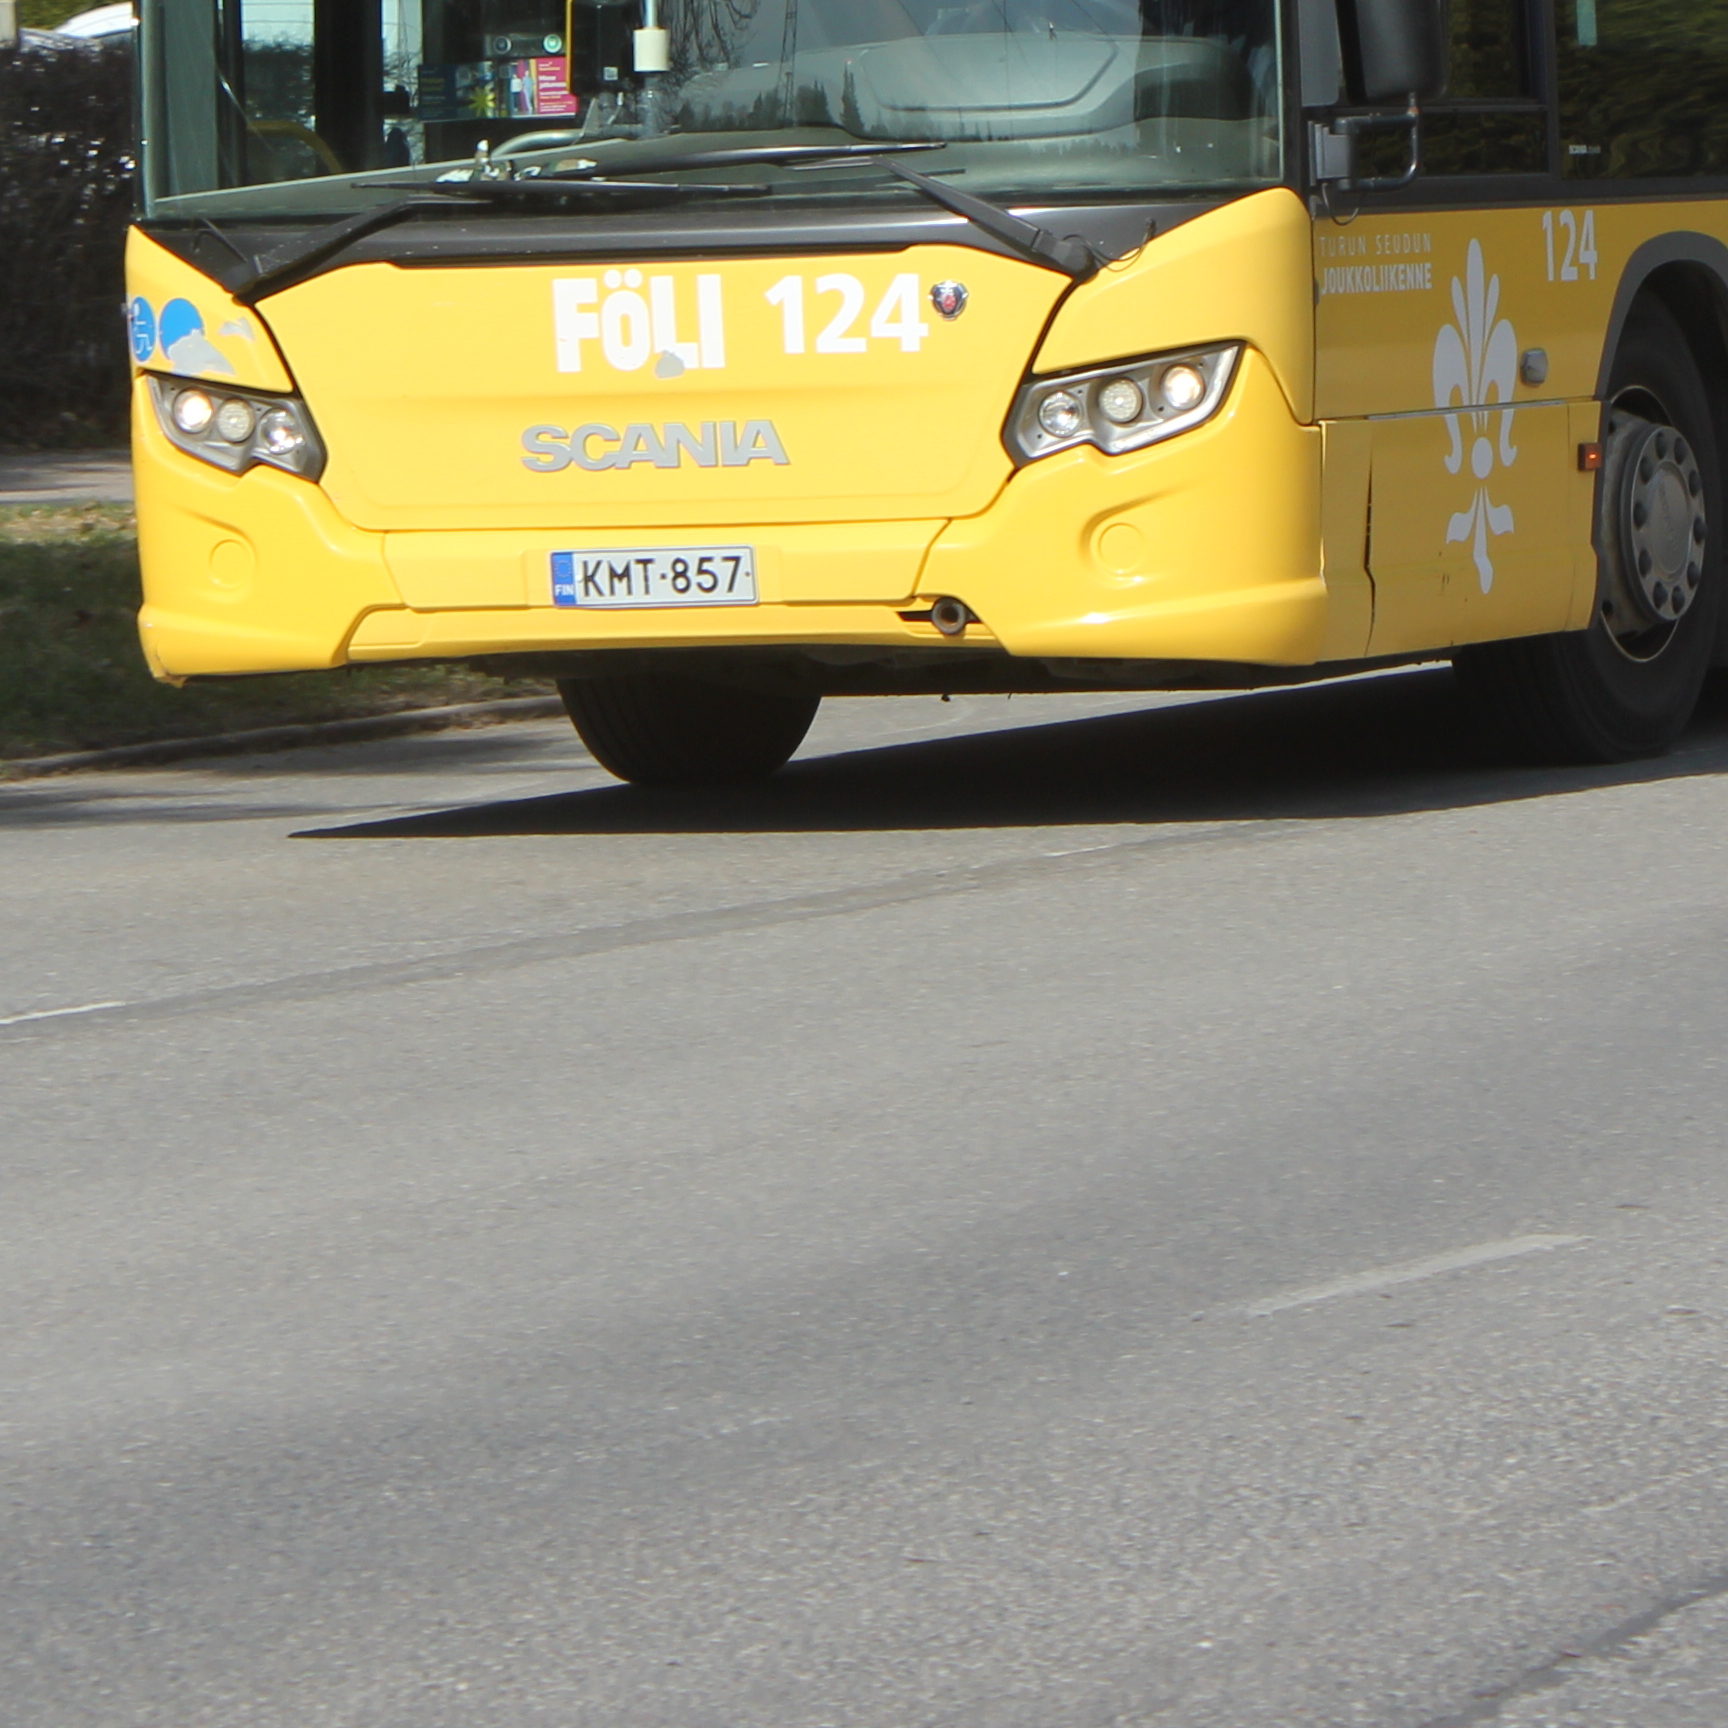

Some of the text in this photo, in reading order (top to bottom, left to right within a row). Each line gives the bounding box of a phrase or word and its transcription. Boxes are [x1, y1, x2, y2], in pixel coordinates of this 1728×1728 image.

[1318, 233, 1432, 257] TURUN SEUDUN
[1541, 209, 1599, 282] 124
[1320, 262, 1433, 295] JOUKKOLIIKENNE
[552, 268, 929, 373] FÖLI 124
[521, 419, 791, 472] SCANIA
[555, 583, 574, 596] FIN
[582, 555, 743, 598] KMT-857
